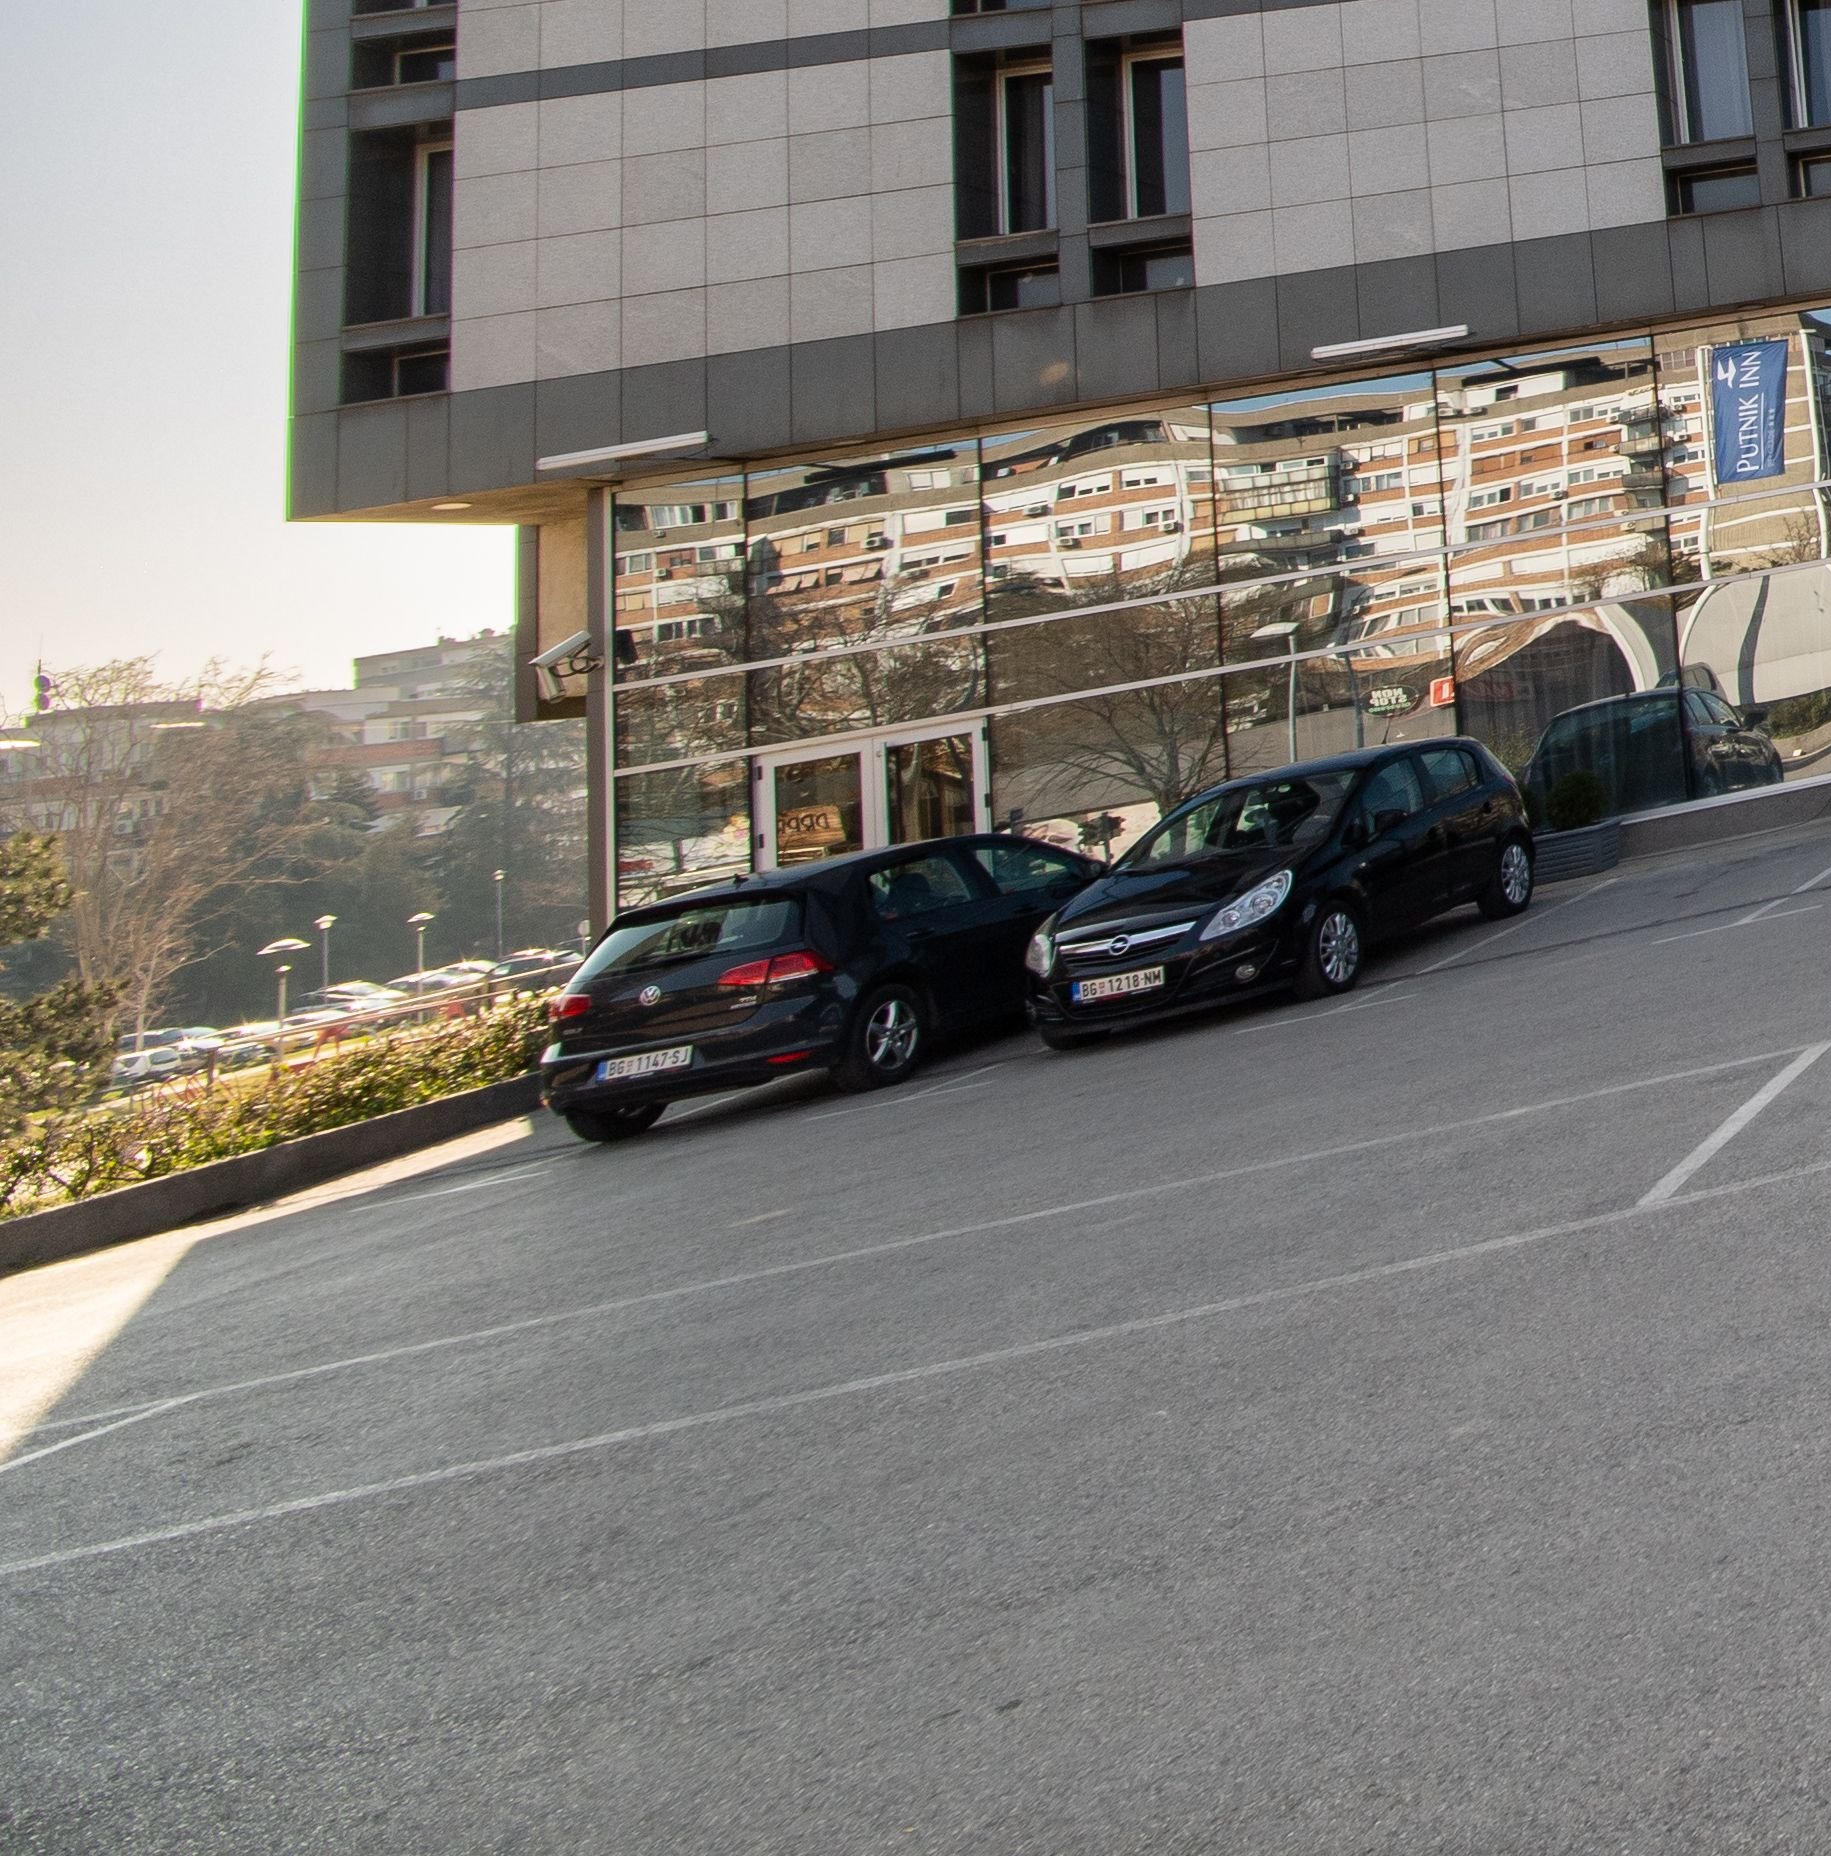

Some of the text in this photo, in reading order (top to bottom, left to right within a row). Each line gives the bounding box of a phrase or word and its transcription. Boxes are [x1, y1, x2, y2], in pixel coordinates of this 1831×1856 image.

[1736, 351, 1762, 473] PUTNIK INN
[1082, 982, 1098, 998] BG
[608, 1059, 626, 1077] BG
